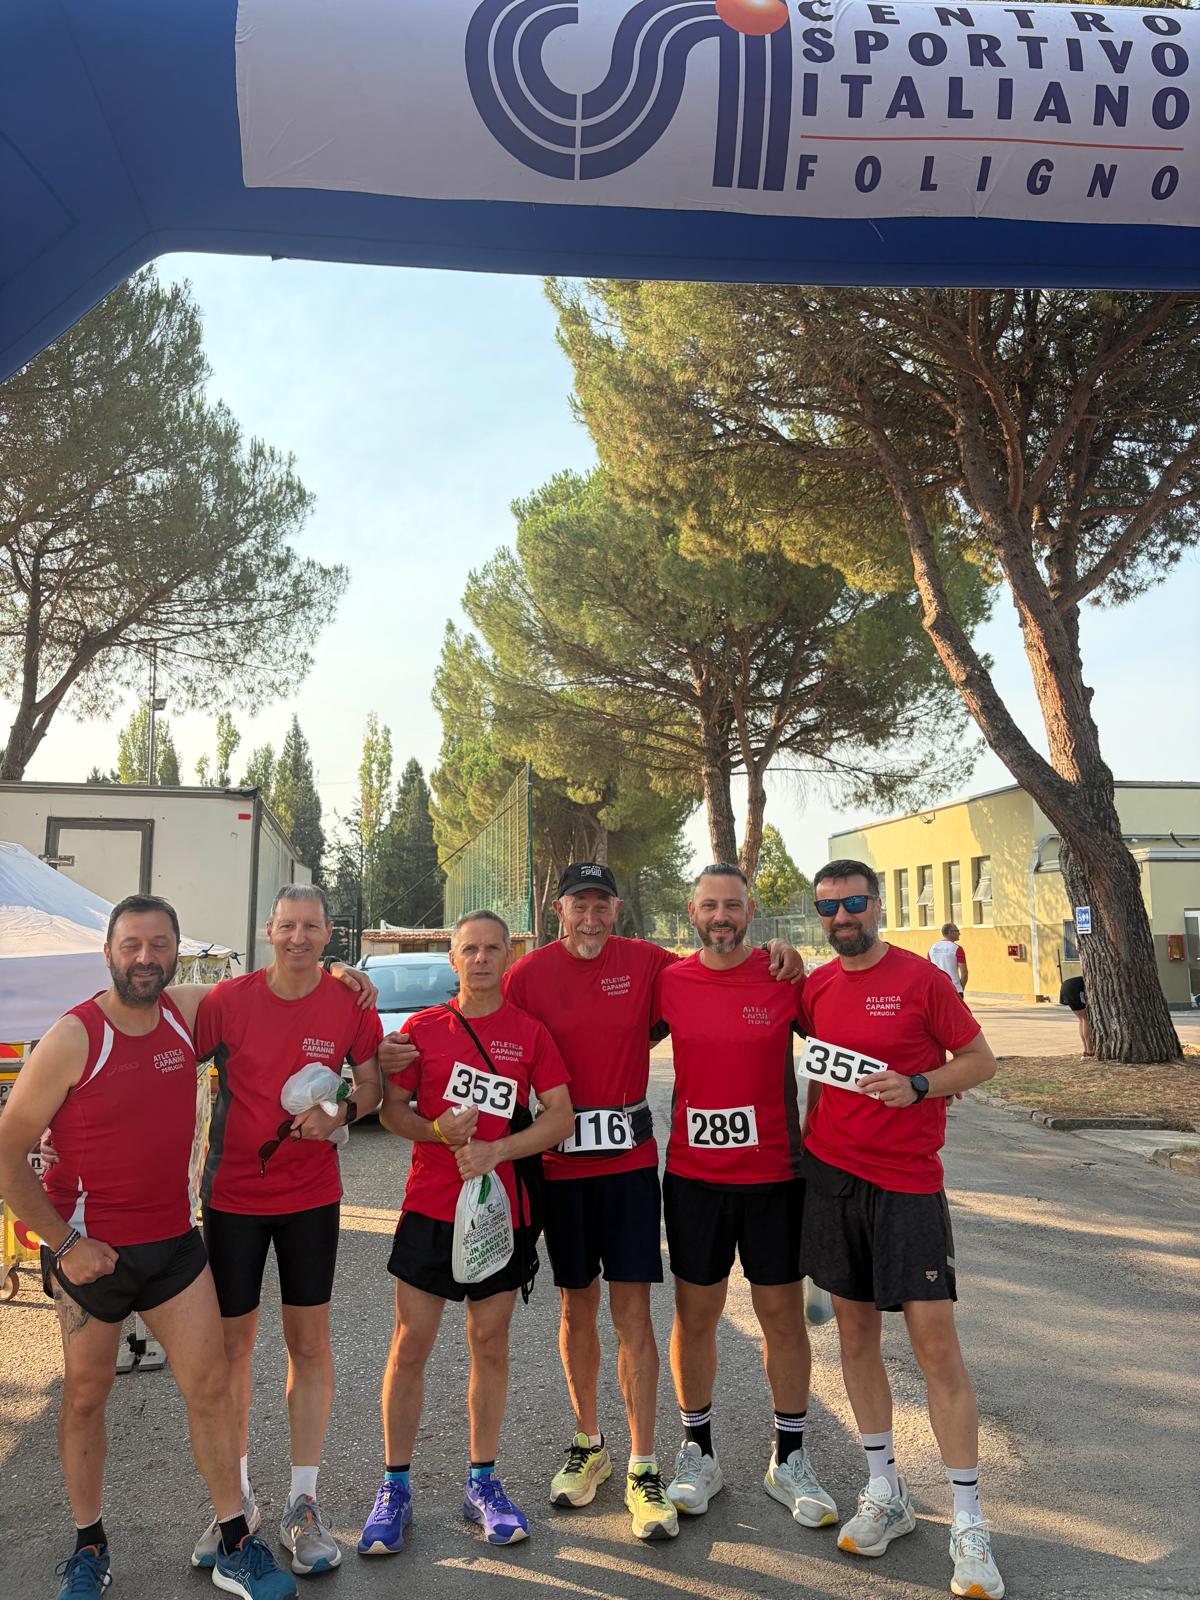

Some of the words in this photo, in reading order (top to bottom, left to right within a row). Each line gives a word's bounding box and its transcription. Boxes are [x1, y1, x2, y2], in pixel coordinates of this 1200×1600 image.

[798, 0, 1182, 36] CENTRO
[801, 27, 1190, 78] SPORTIVO
[801, 72, 1191, 131] ITALIANO
[796, 154, 1180, 201] FOLIGNO
[600, 975, 631, 986] ATLETICA
[865, 995, 902, 1003] ATLETICA
[303, 1037, 335, 1048] ATLETICA
[490, 1040, 523, 1050] ATLETICA
[153, 1048, 185, 1062] ATLETICA
[302, 1045, 335, 1055] CAPANNE
[490, 1048, 523, 1057] CAPANNE
[154, 1055, 186, 1069] CAPANNE
[161, 1063, 184, 1074] PERUGIA
[452, 1069, 513, 1110] 353
[574, 1113, 626, 1147] 116
[691, 1111, 750, 1146] 289
[480, 1231, 503, 1250] SACCO
